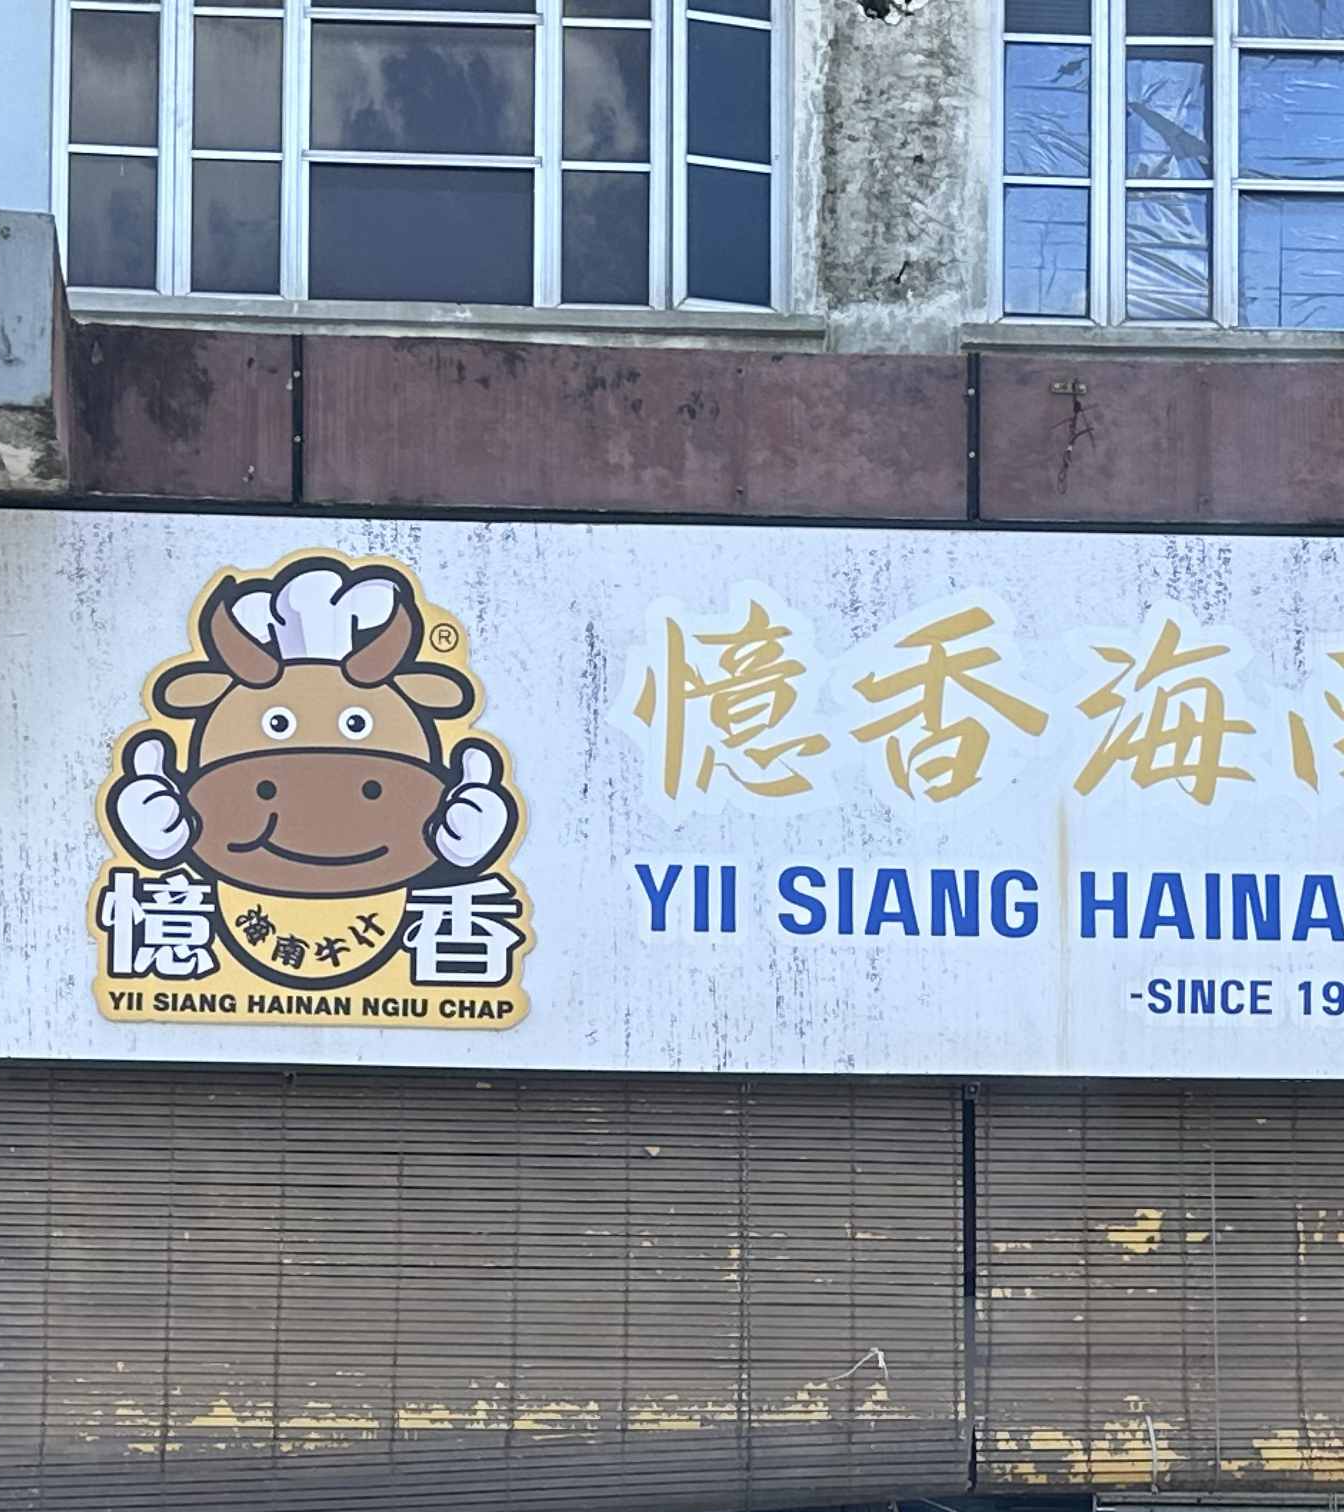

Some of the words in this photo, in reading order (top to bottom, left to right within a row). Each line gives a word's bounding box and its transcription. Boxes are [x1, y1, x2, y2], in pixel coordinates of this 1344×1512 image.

[635, 862, 738, 933] YII
[776, 864, 1040, 938] SIANG
[108, 991, 143, 1011] YII
[153, 992, 237, 1013] SIANG
[247, 995, 352, 1016] HAINAN
[362, 998, 429, 1018] NGIU
[438, 1000, 514, 1020] CHAP
